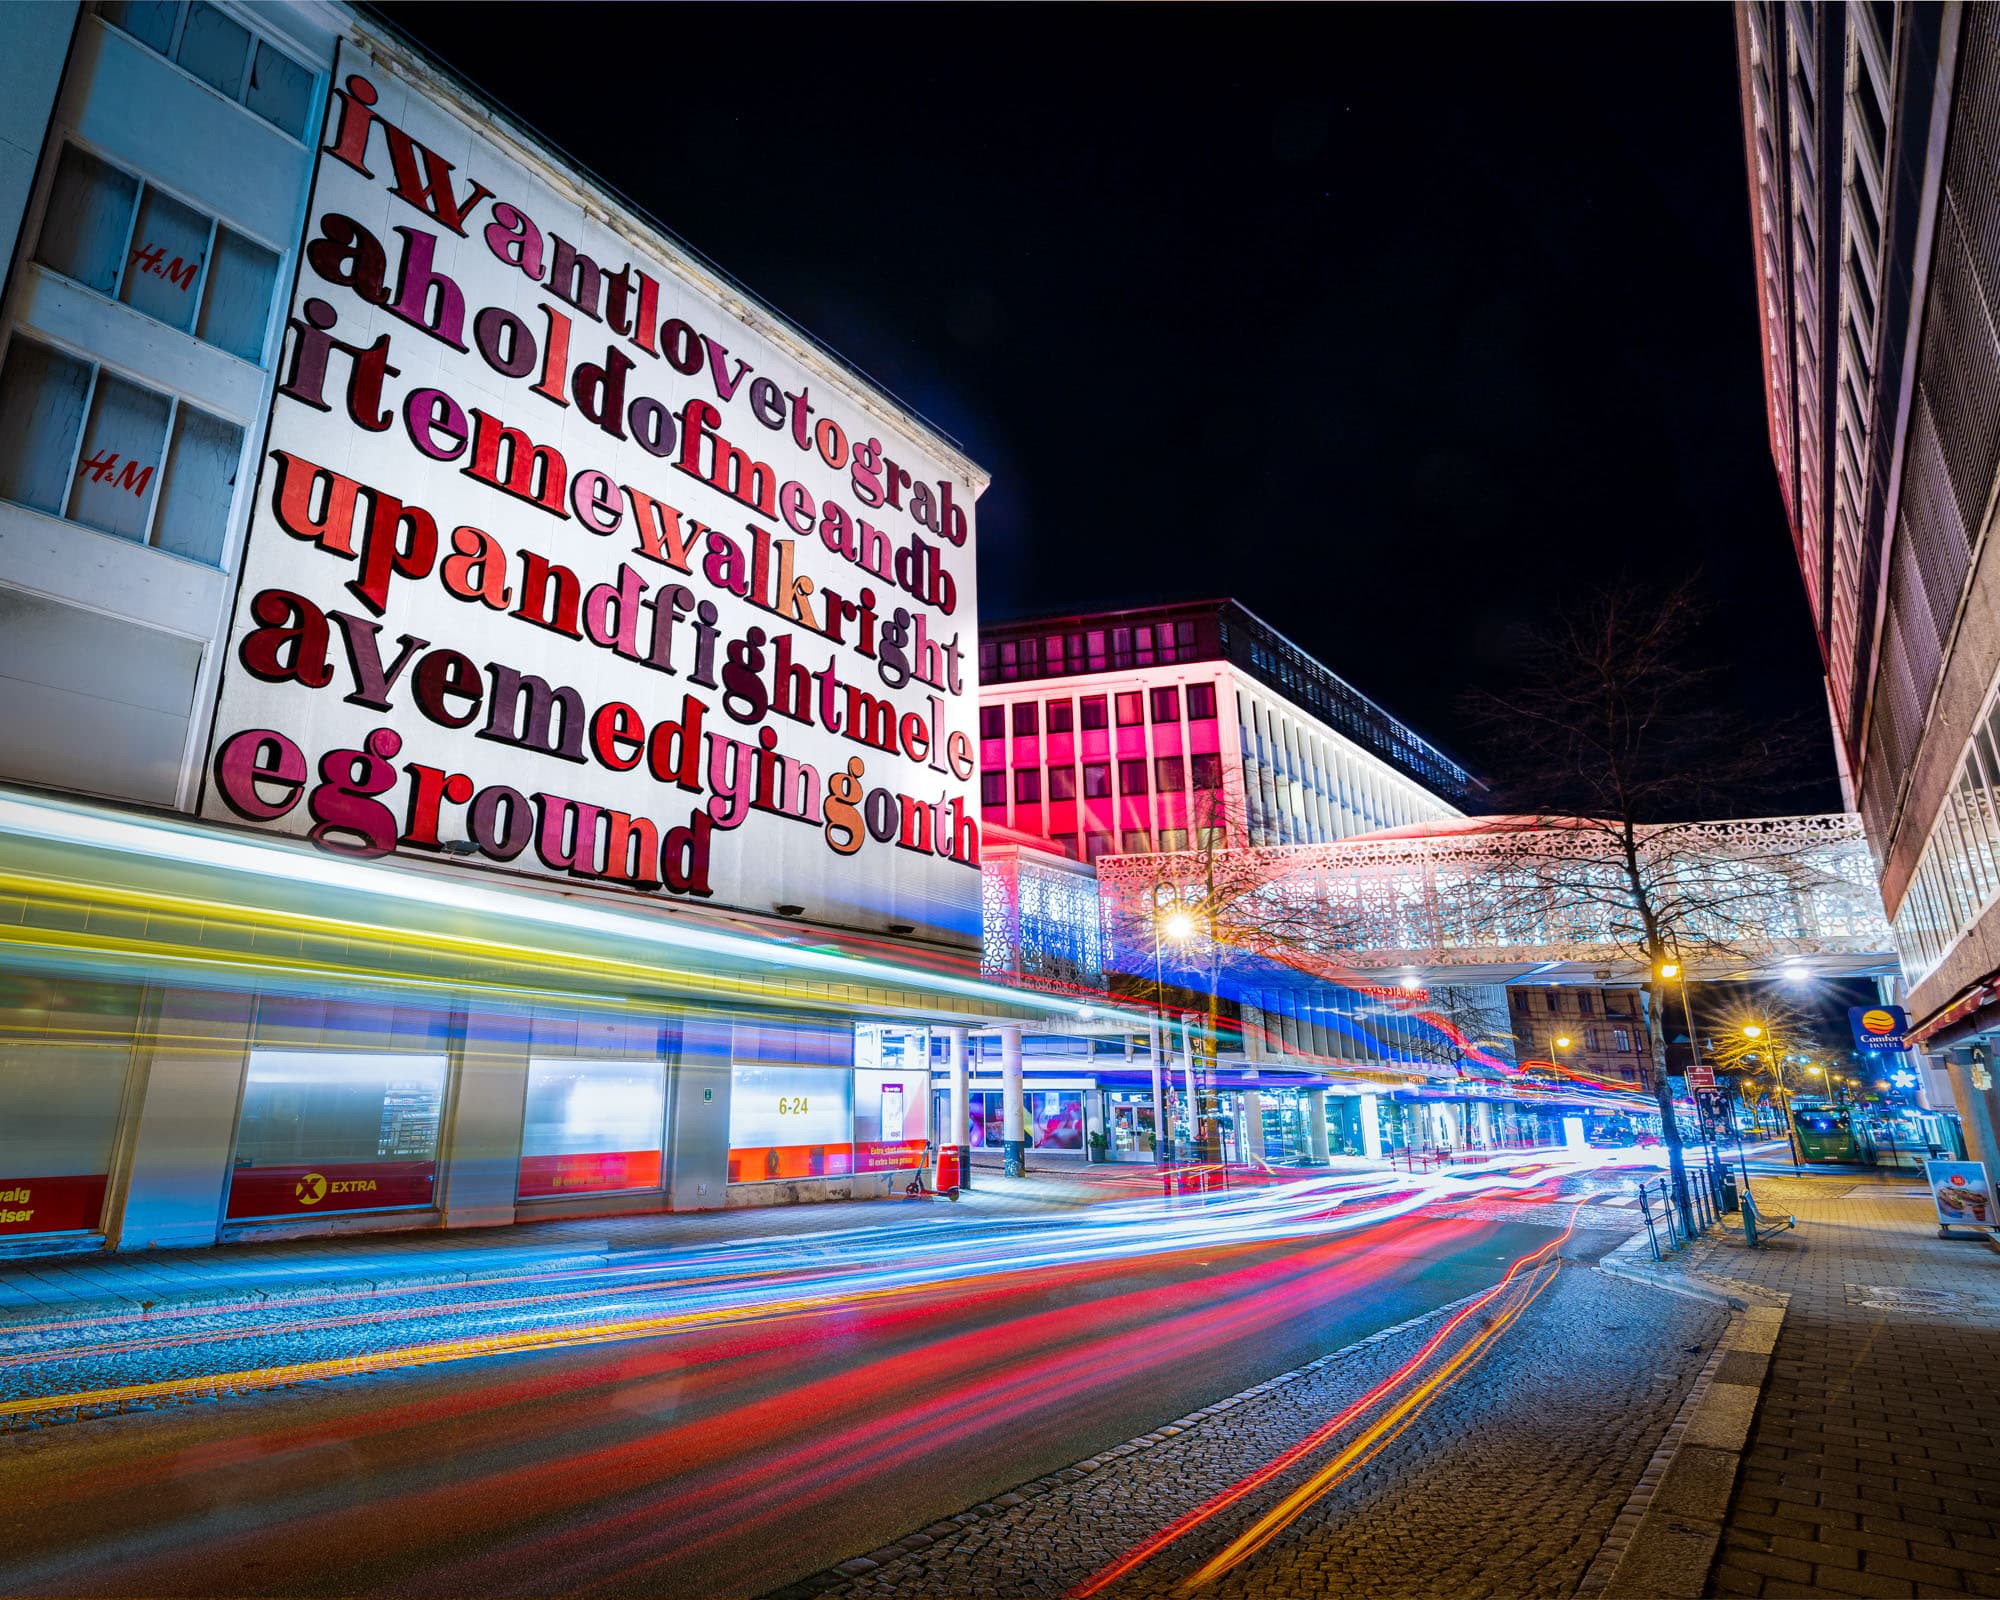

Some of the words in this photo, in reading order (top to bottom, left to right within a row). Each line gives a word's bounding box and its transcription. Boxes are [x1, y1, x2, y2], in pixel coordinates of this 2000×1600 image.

[130, 243, 199, 293] H&M
[79, 449, 154, 498] H&M
[213, 727, 714, 898] eground
[779, 1097, 808, 1115] 6-24
[331, 1180, 377, 1193] EXTRA
